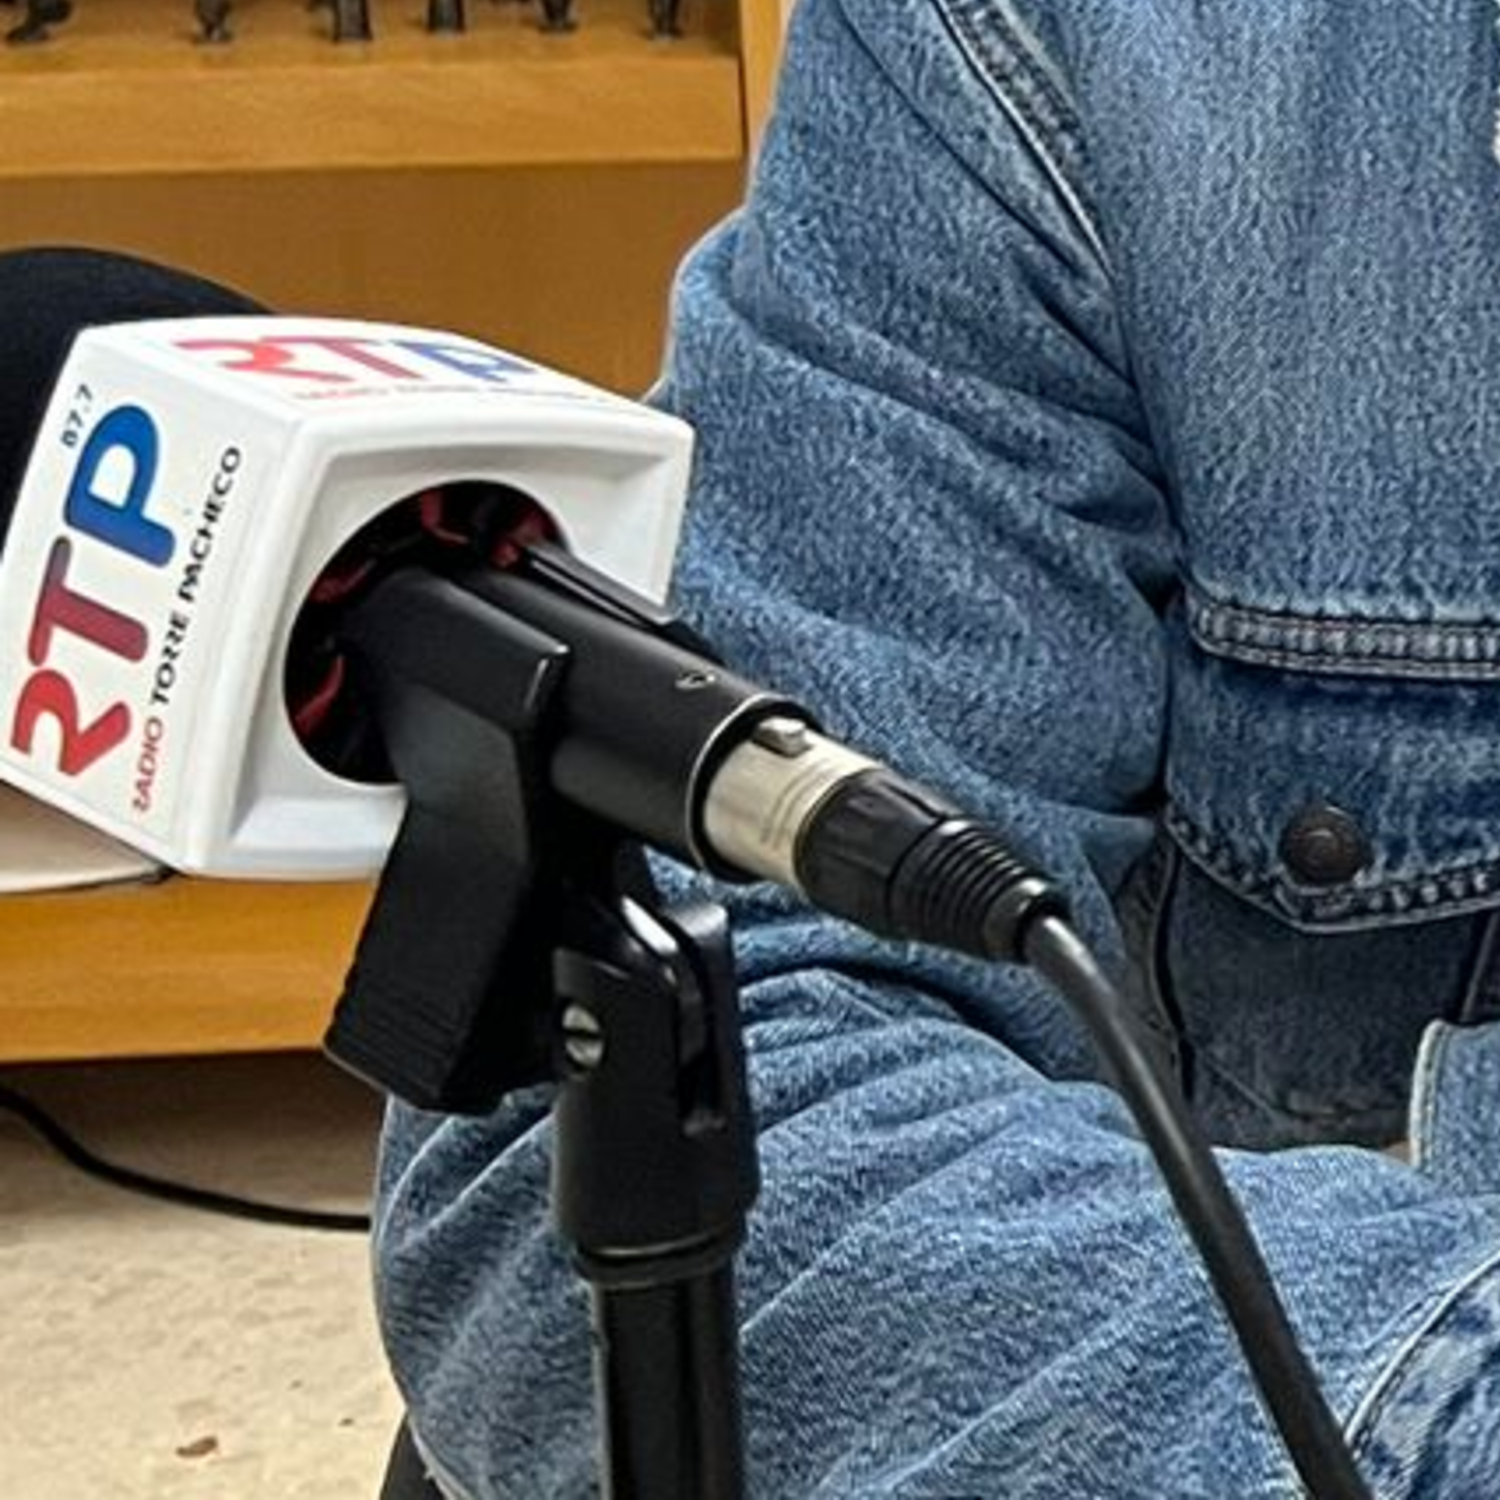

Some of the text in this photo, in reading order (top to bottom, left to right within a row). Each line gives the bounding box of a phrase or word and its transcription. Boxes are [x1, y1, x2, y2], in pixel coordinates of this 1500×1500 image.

[60, 384, 93, 449] 87.7
[171, 335, 540, 383] RTP
[9, 404, 177, 776] RTP
[131, 447, 241, 812] RADIO TORRE PACHECO
